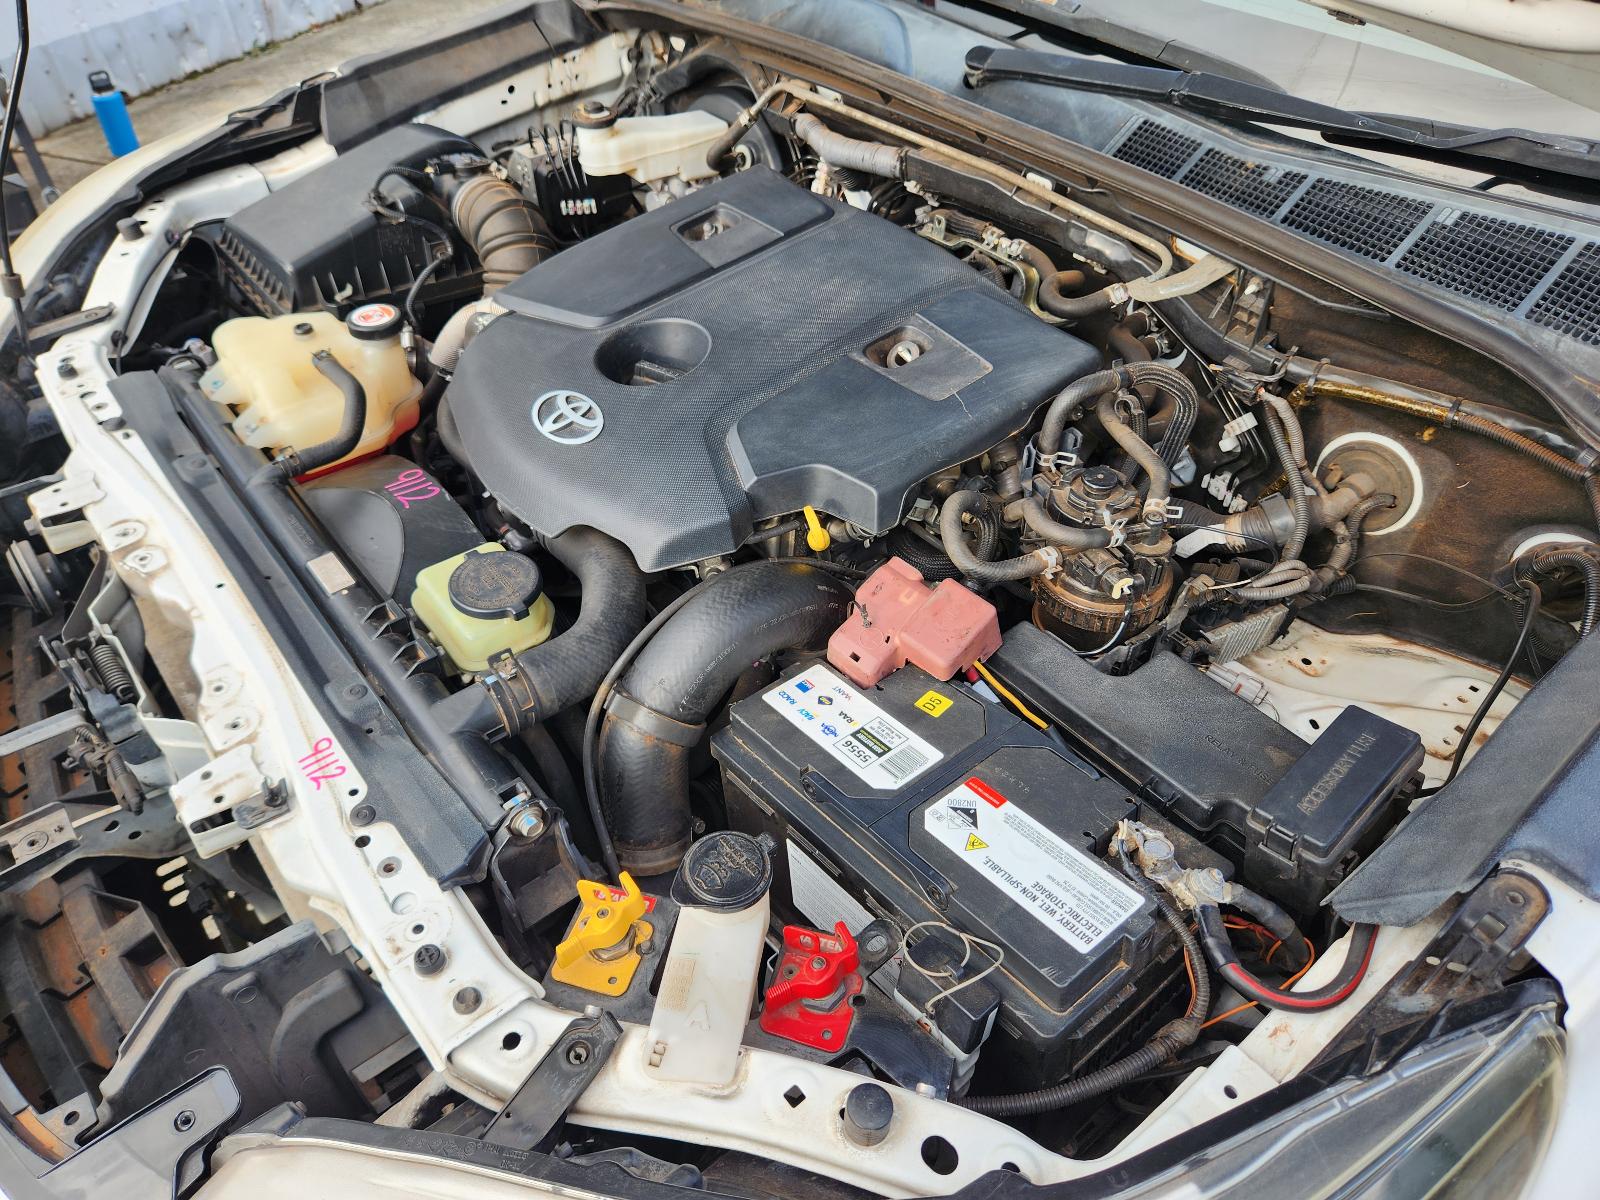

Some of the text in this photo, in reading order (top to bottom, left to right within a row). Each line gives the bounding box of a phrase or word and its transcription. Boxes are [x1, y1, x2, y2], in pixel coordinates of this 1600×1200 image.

[384, 468, 440, 509] 9112
[838, 710, 855, 724] RAA
[923, 697, 942, 712] D5
[298, 737, 346, 790] 9112
[841, 740, 872, 763] 5556
[1297, 753, 1354, 816] ACCESSORY
[947, 797, 978, 809] UN2800
[980, 855, 1040, 902] NON-SPILLABLE,
[1030, 880, 1067, 910] STORAGE
[1054, 912, 1095, 945] BATTERY,
[1063, 905, 1103, 937] ELECTRIC
